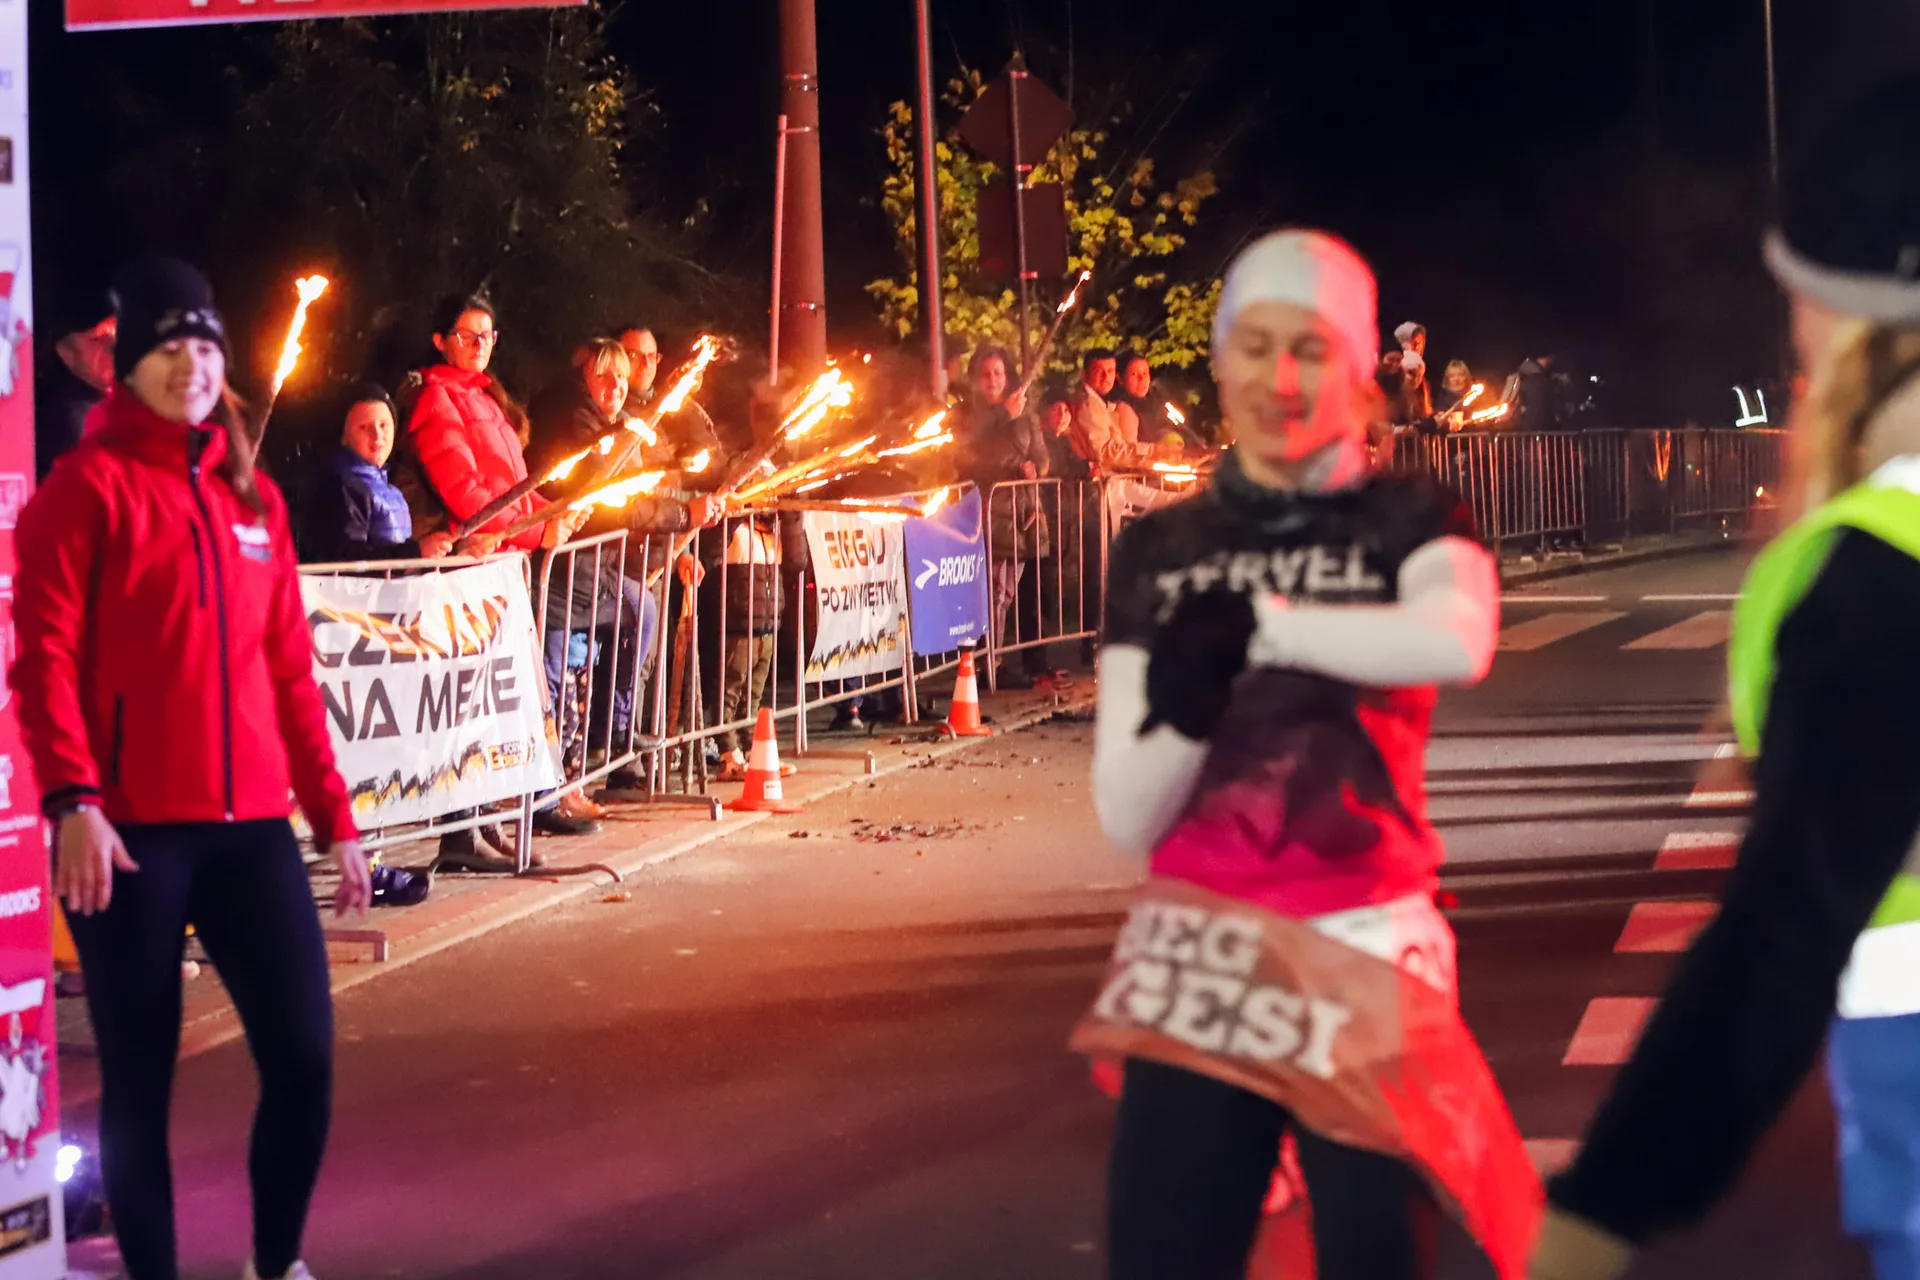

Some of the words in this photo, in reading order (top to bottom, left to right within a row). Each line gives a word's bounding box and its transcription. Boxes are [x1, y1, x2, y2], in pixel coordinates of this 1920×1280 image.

[938, 555, 976, 587] BROOKS
[821, 586, 840, 614] PO
[319, 677, 401, 742] NA
